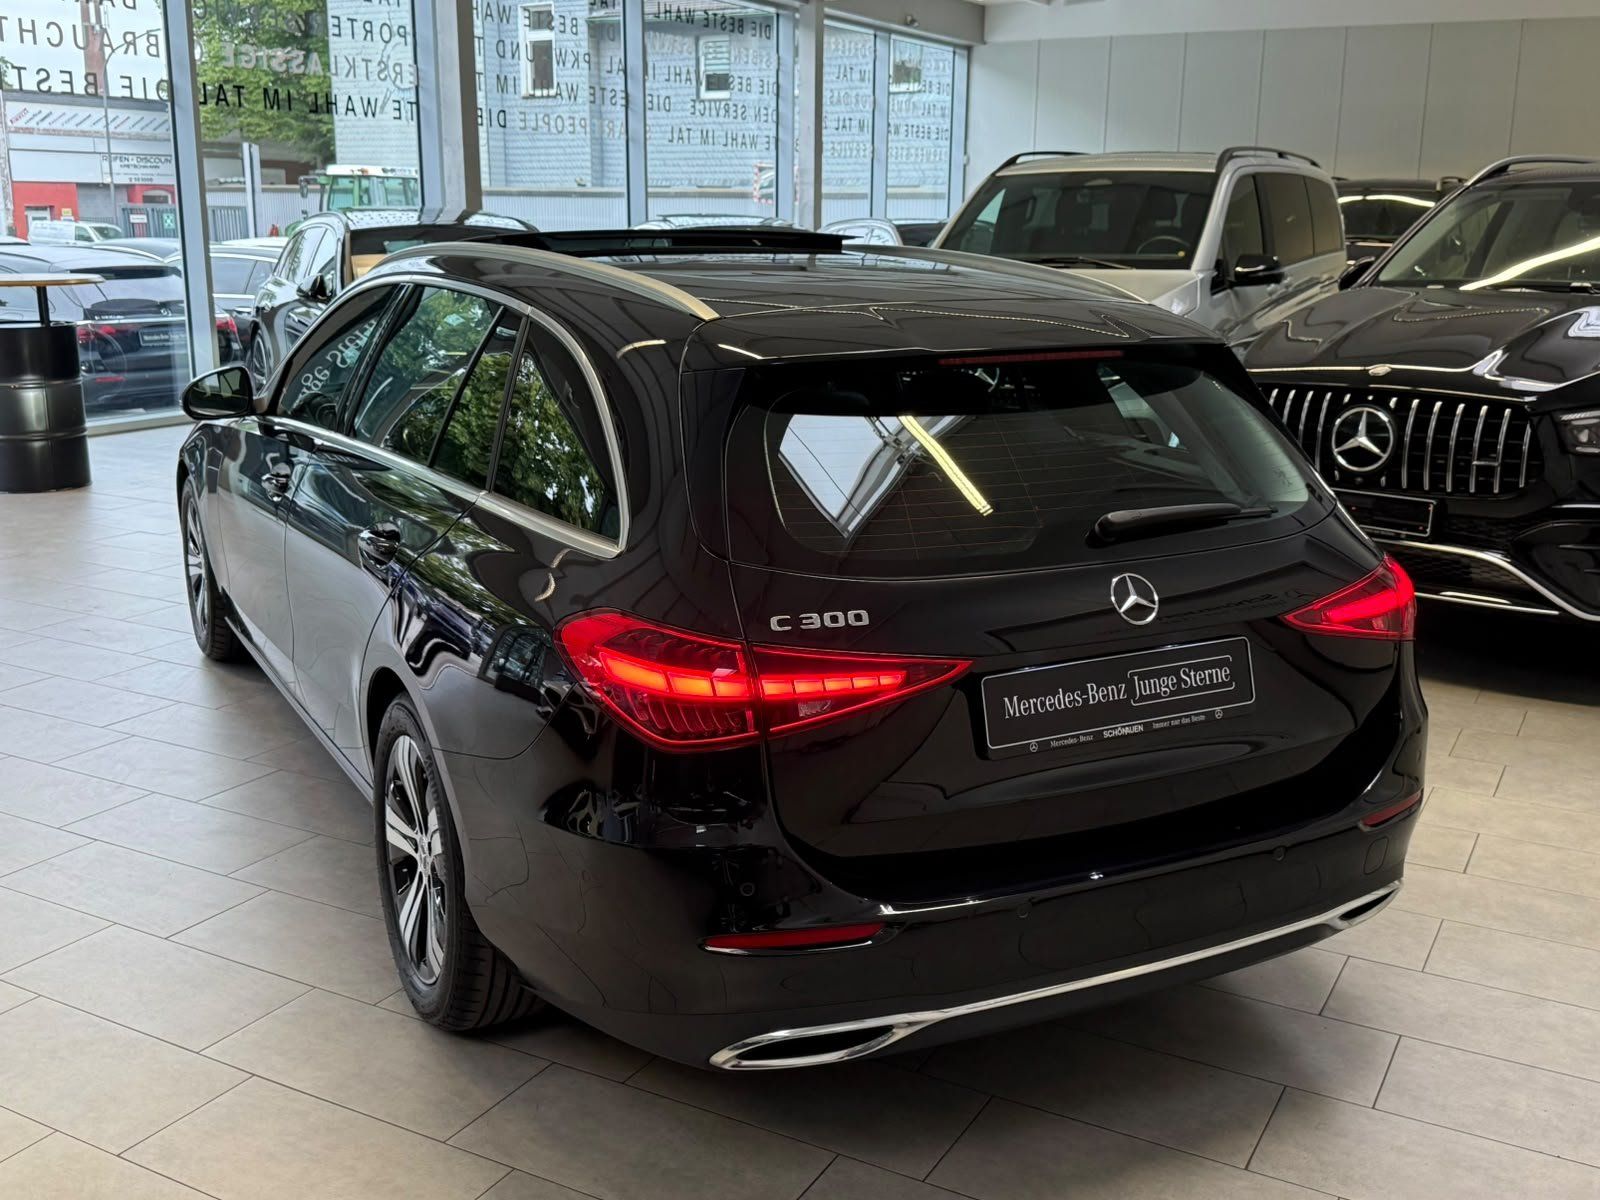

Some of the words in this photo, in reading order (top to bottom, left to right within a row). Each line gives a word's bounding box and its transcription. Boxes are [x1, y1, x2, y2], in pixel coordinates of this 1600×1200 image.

[770, 615, 792, 631] C
[799, 609, 869, 630] 300
[1003, 683, 1127, 719] Mercedes-Benz
[1133, 675, 1177, 701] Junge
[1180, 666, 1230, 689] Sterne
